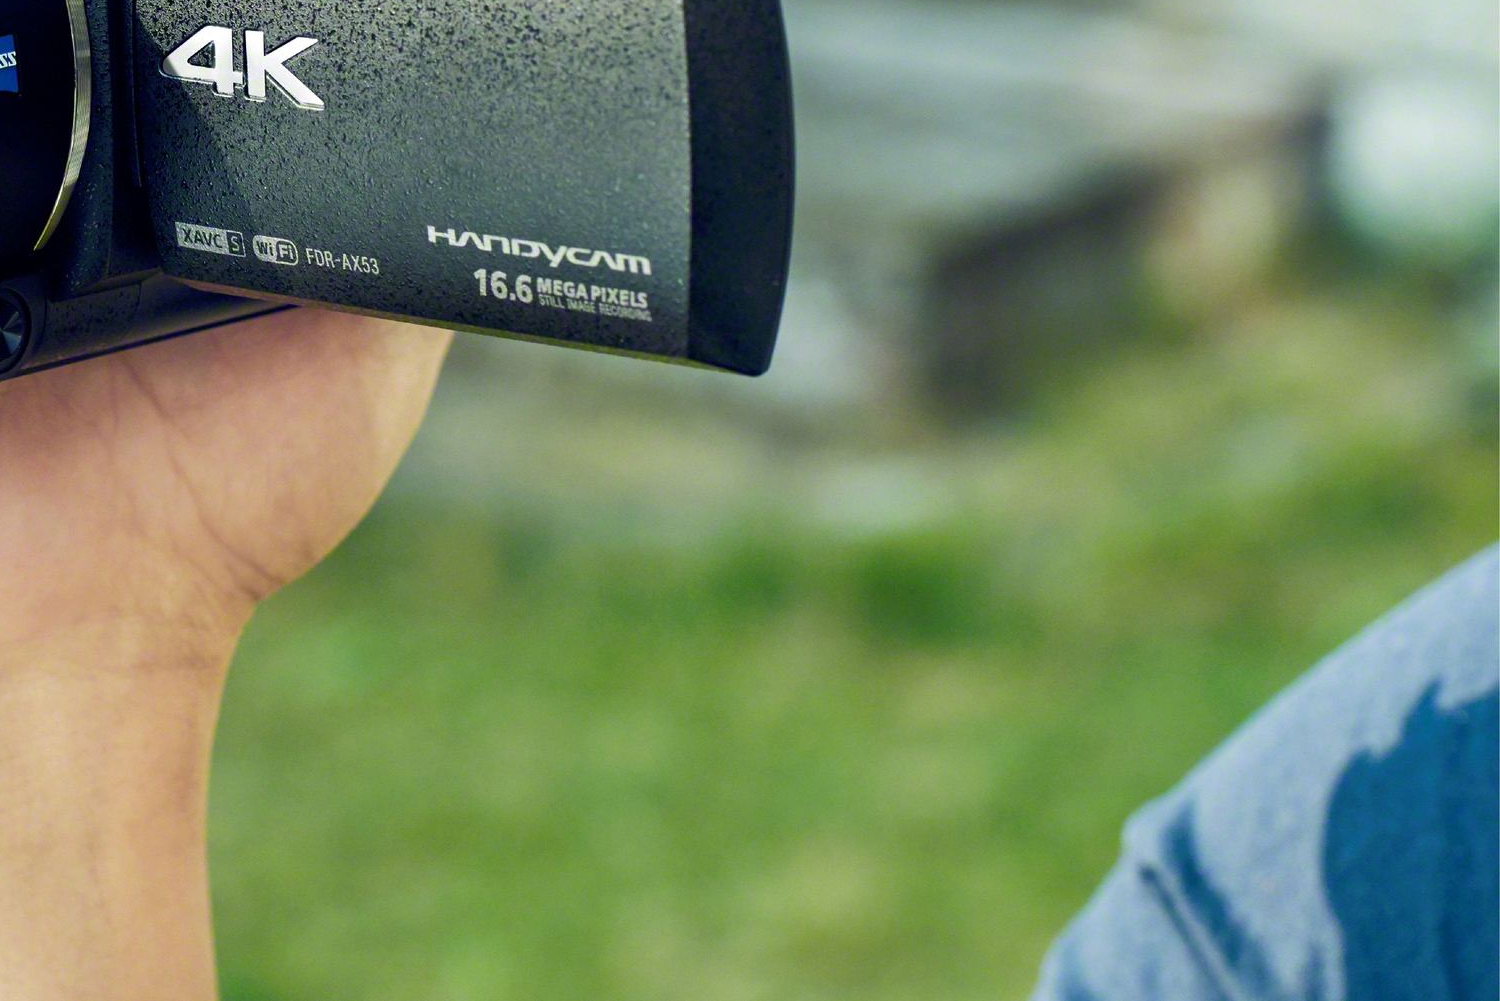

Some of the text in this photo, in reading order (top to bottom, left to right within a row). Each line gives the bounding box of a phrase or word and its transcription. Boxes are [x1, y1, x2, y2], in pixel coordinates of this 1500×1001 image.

[159, 25, 325, 111] 4K
[182, 228, 223, 249] XAVC
[305, 248, 380, 275] FDR-AX53
[473, 268, 534, 304] 16.6
[536, 277, 648, 309] MEGA PIXELS
[539, 294, 653, 322] STILL IMAGE RECORDING
